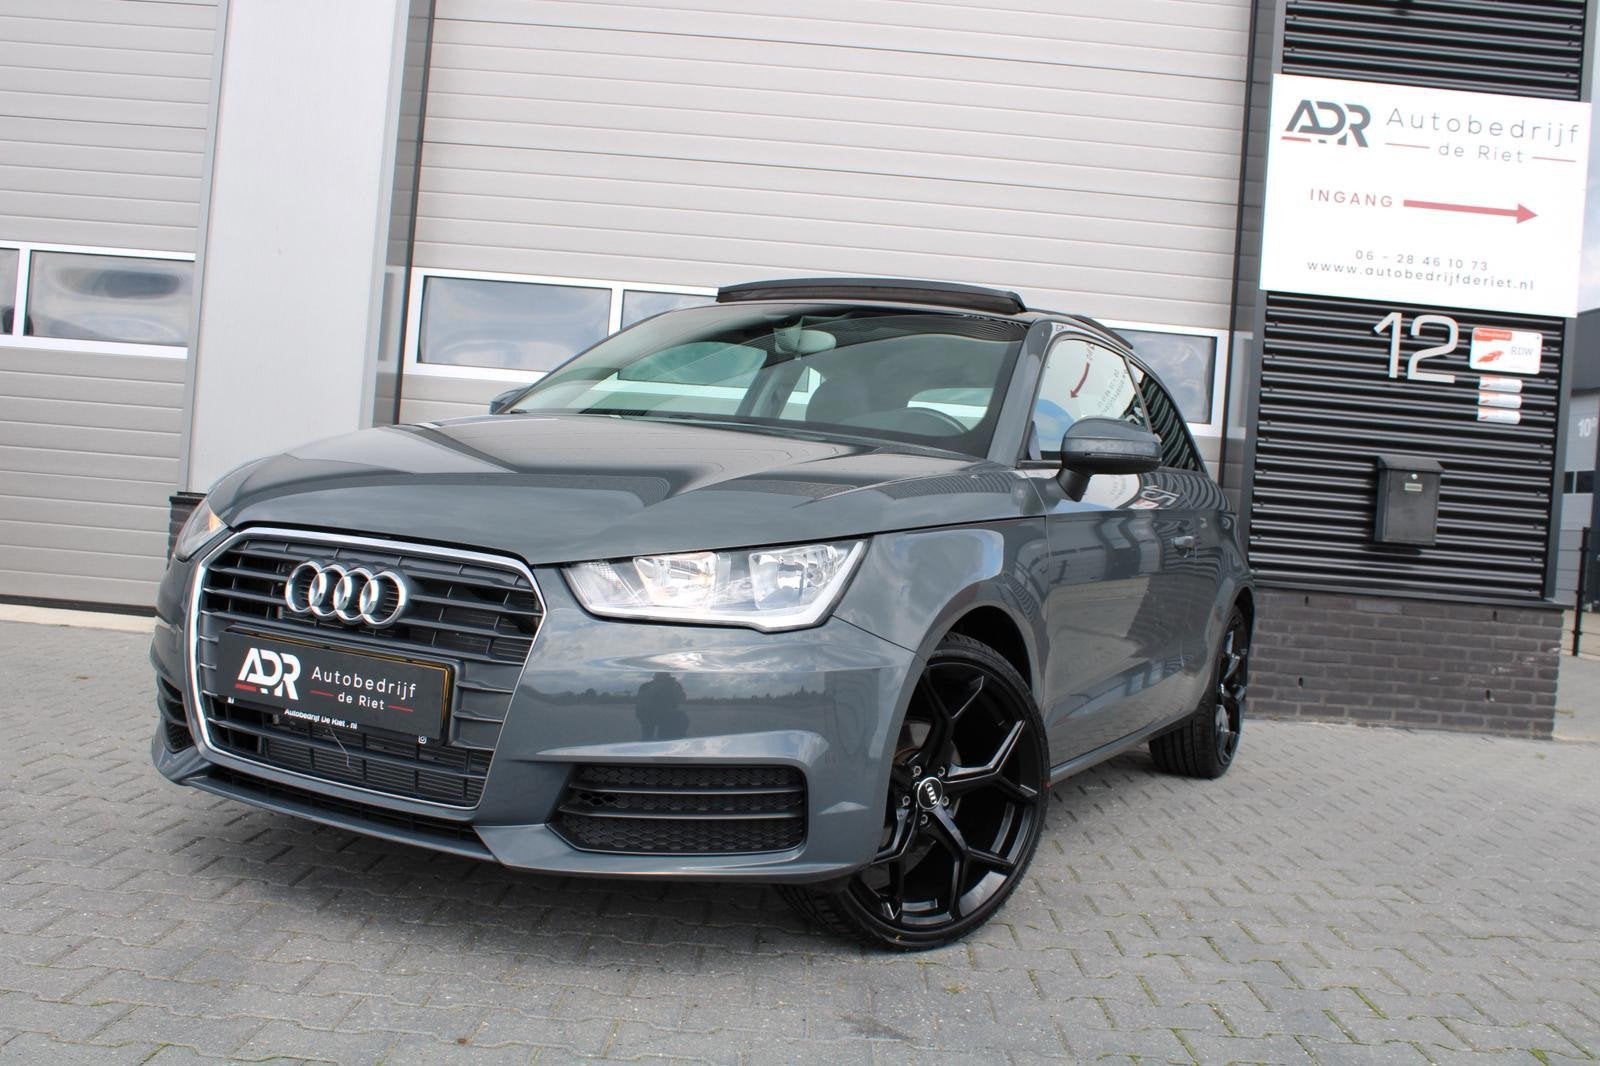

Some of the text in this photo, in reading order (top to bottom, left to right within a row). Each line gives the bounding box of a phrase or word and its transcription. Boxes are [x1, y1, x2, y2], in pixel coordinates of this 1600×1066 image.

[1285, 100, 1579, 148] ADR Autobedrijf
[1438, 143, 1524, 163] de Riet
[1309, 188, 1394, 208] INGANG
[1355, 249, 1374, 261] 06
[1397, 253, 1414, 265] 28
[1422, 256, 1441, 267] 46
[1449, 258, 1464, 269] 10
[1472, 260, 1488, 272] 73
[1373, 311, 1460, 384] 12
[237, 647, 417, 701] ADR Autobedrijf
[337, 691, 385, 710] de Riet
